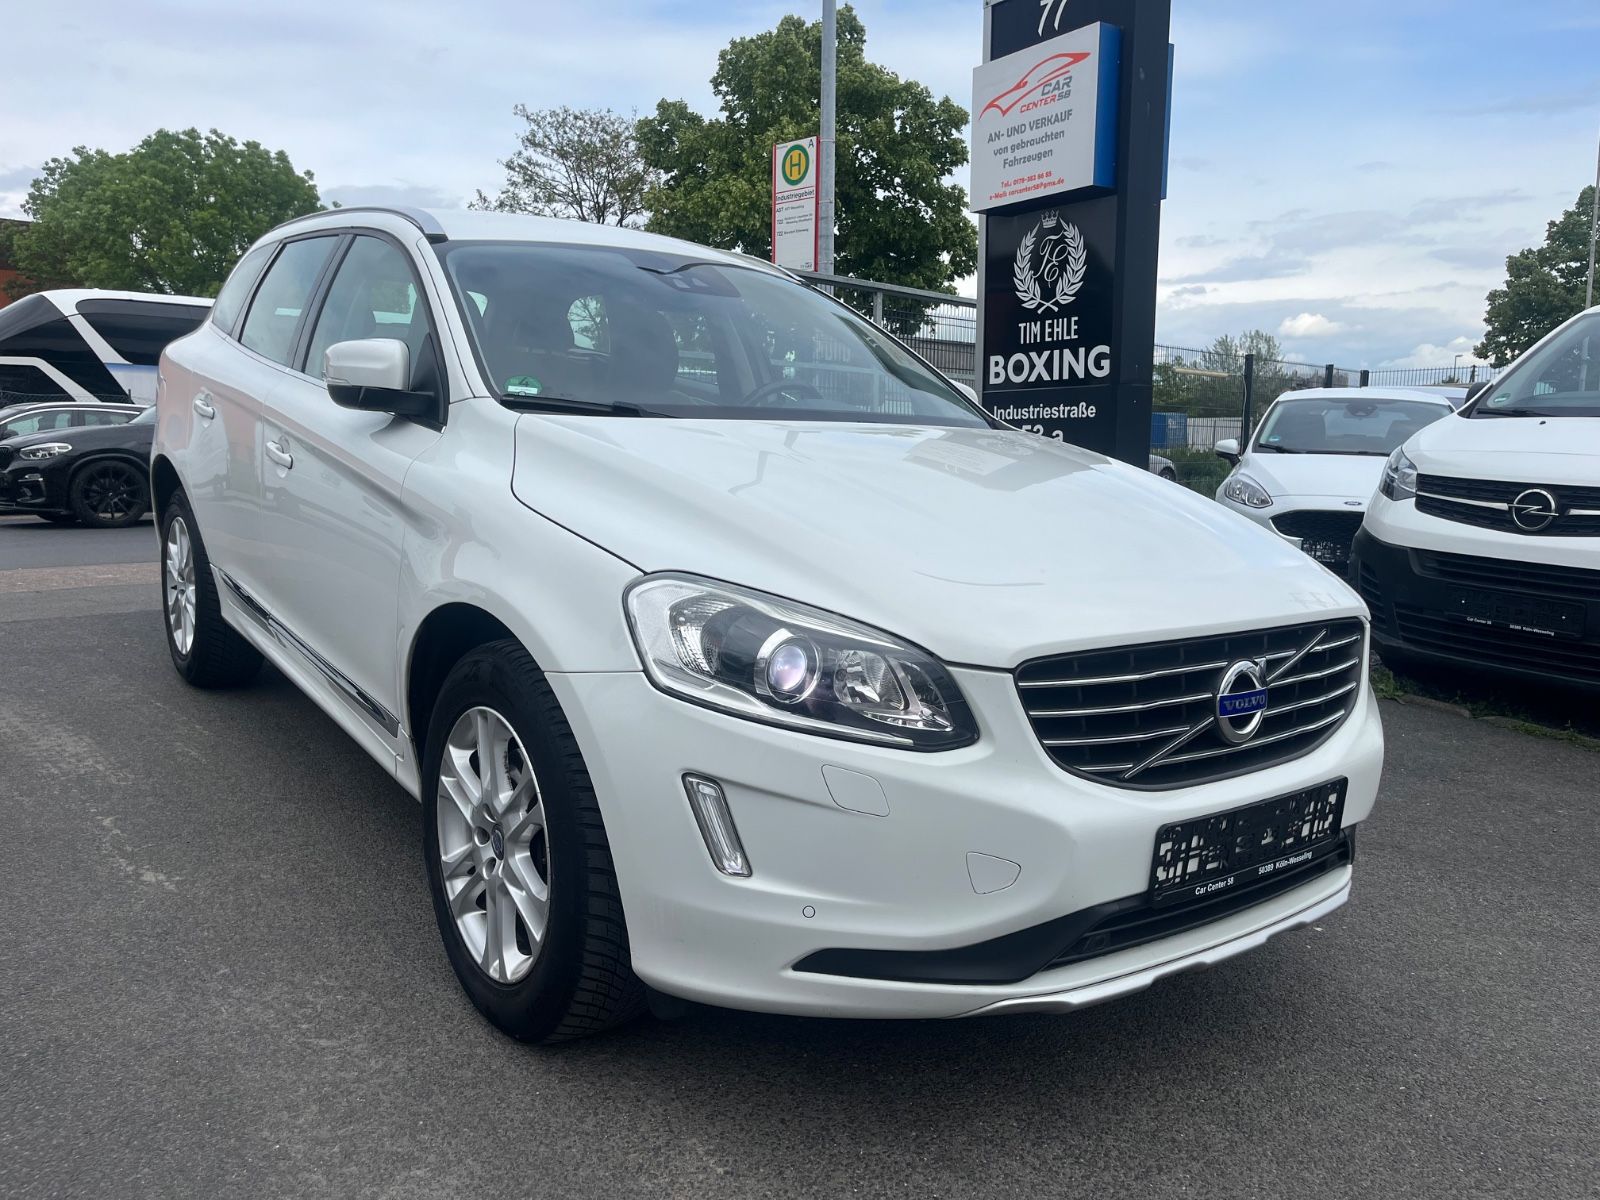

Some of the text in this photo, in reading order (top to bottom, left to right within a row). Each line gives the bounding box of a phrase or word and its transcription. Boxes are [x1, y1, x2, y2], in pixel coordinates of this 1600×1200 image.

[1041, 76, 1072, 97] CAR
[987, 108, 1073, 144] AN- UND VERKAUF
[808, 138, 814, 149] A
[993, 130, 1065, 156] von gebrauchten
[1003, 149, 1053, 169] Fahrzeugen
[1018, 316, 1079, 345] TIM EHLE
[989, 345, 1111, 385] BOXING
[993, 401, 1096, 420] Industriestraße
[1223, 694, 1265, 711] VOLVO
[1195, 886, 1207, 895] Car
[1207, 881, 1227, 892] Center
[1227, 877, 1234, 886] 58
